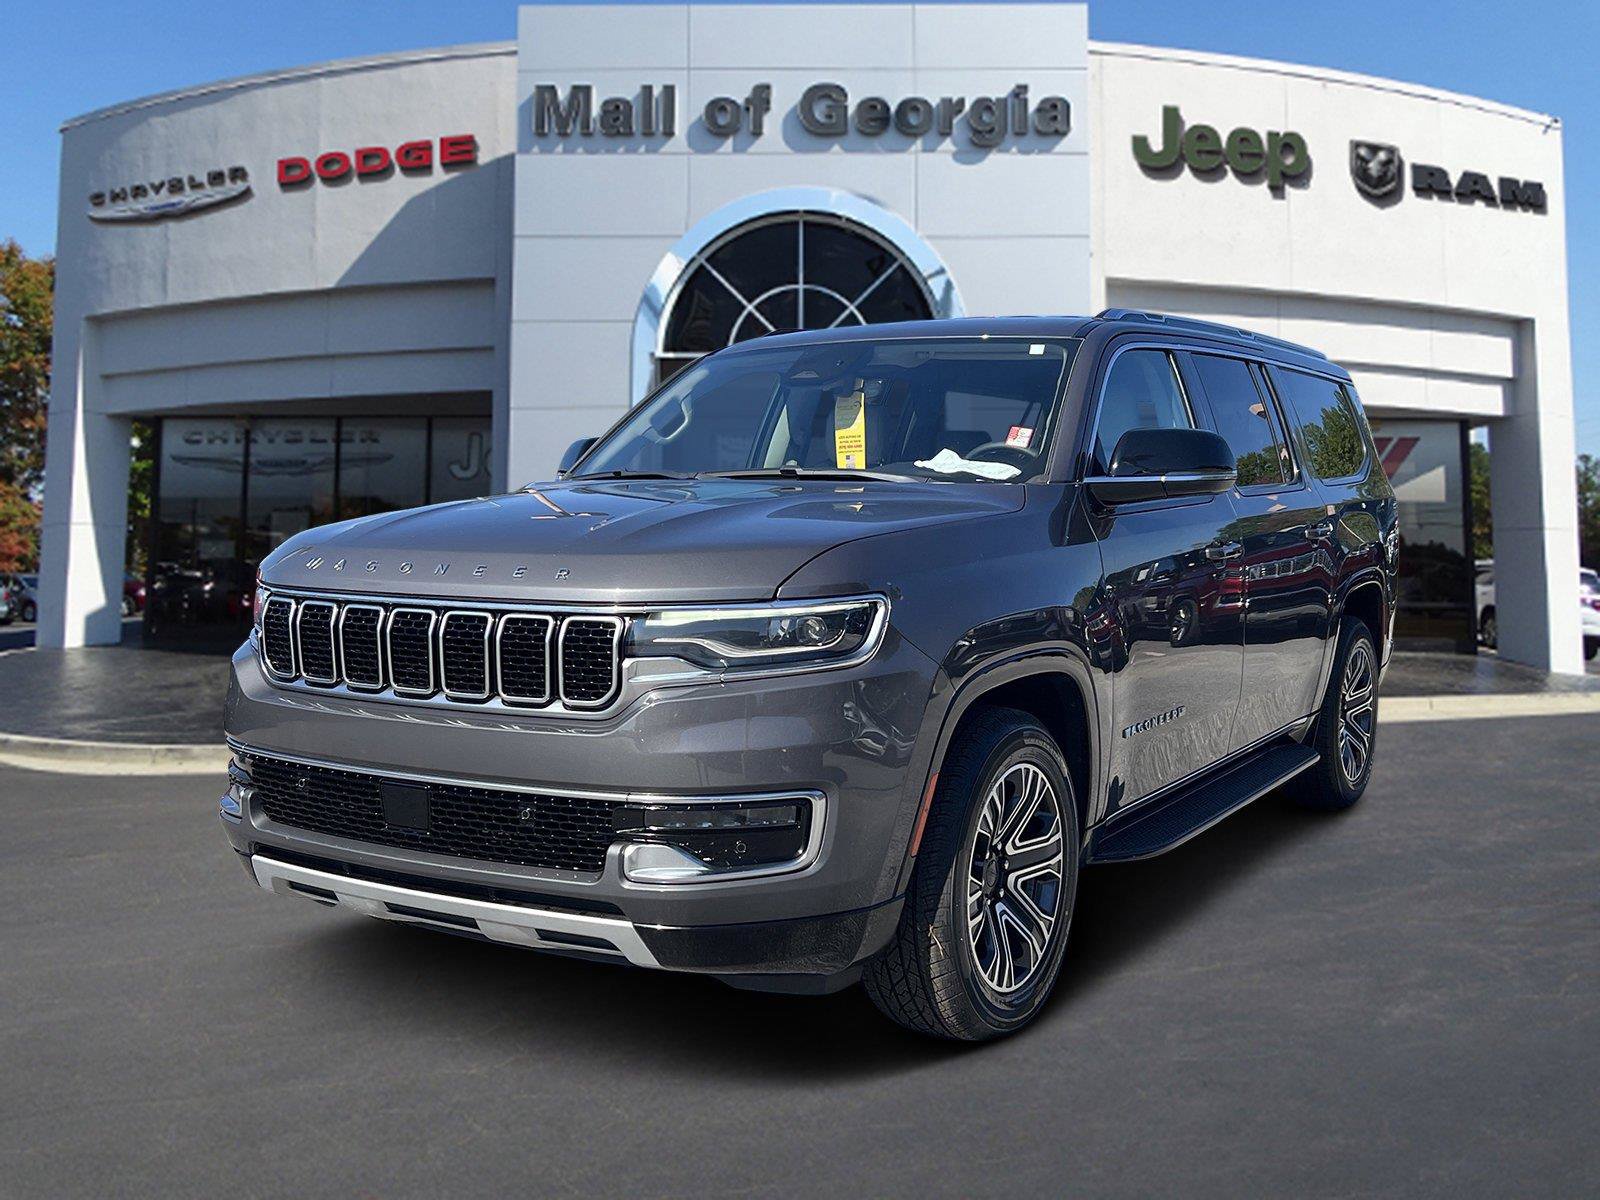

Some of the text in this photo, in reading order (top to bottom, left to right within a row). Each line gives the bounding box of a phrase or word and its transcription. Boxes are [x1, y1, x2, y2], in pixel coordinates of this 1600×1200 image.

[532, 82, 1072, 149] Mall of Georgia
[277, 134, 477, 190] DODGE
[1131, 105, 1310, 198] Jeep
[89, 166, 249, 207] CHRYSLER
[1411, 163, 1547, 214] RAM
[305, 556, 571, 581] WAGONEER
[1122, 707, 1181, 739] WAGONEER
